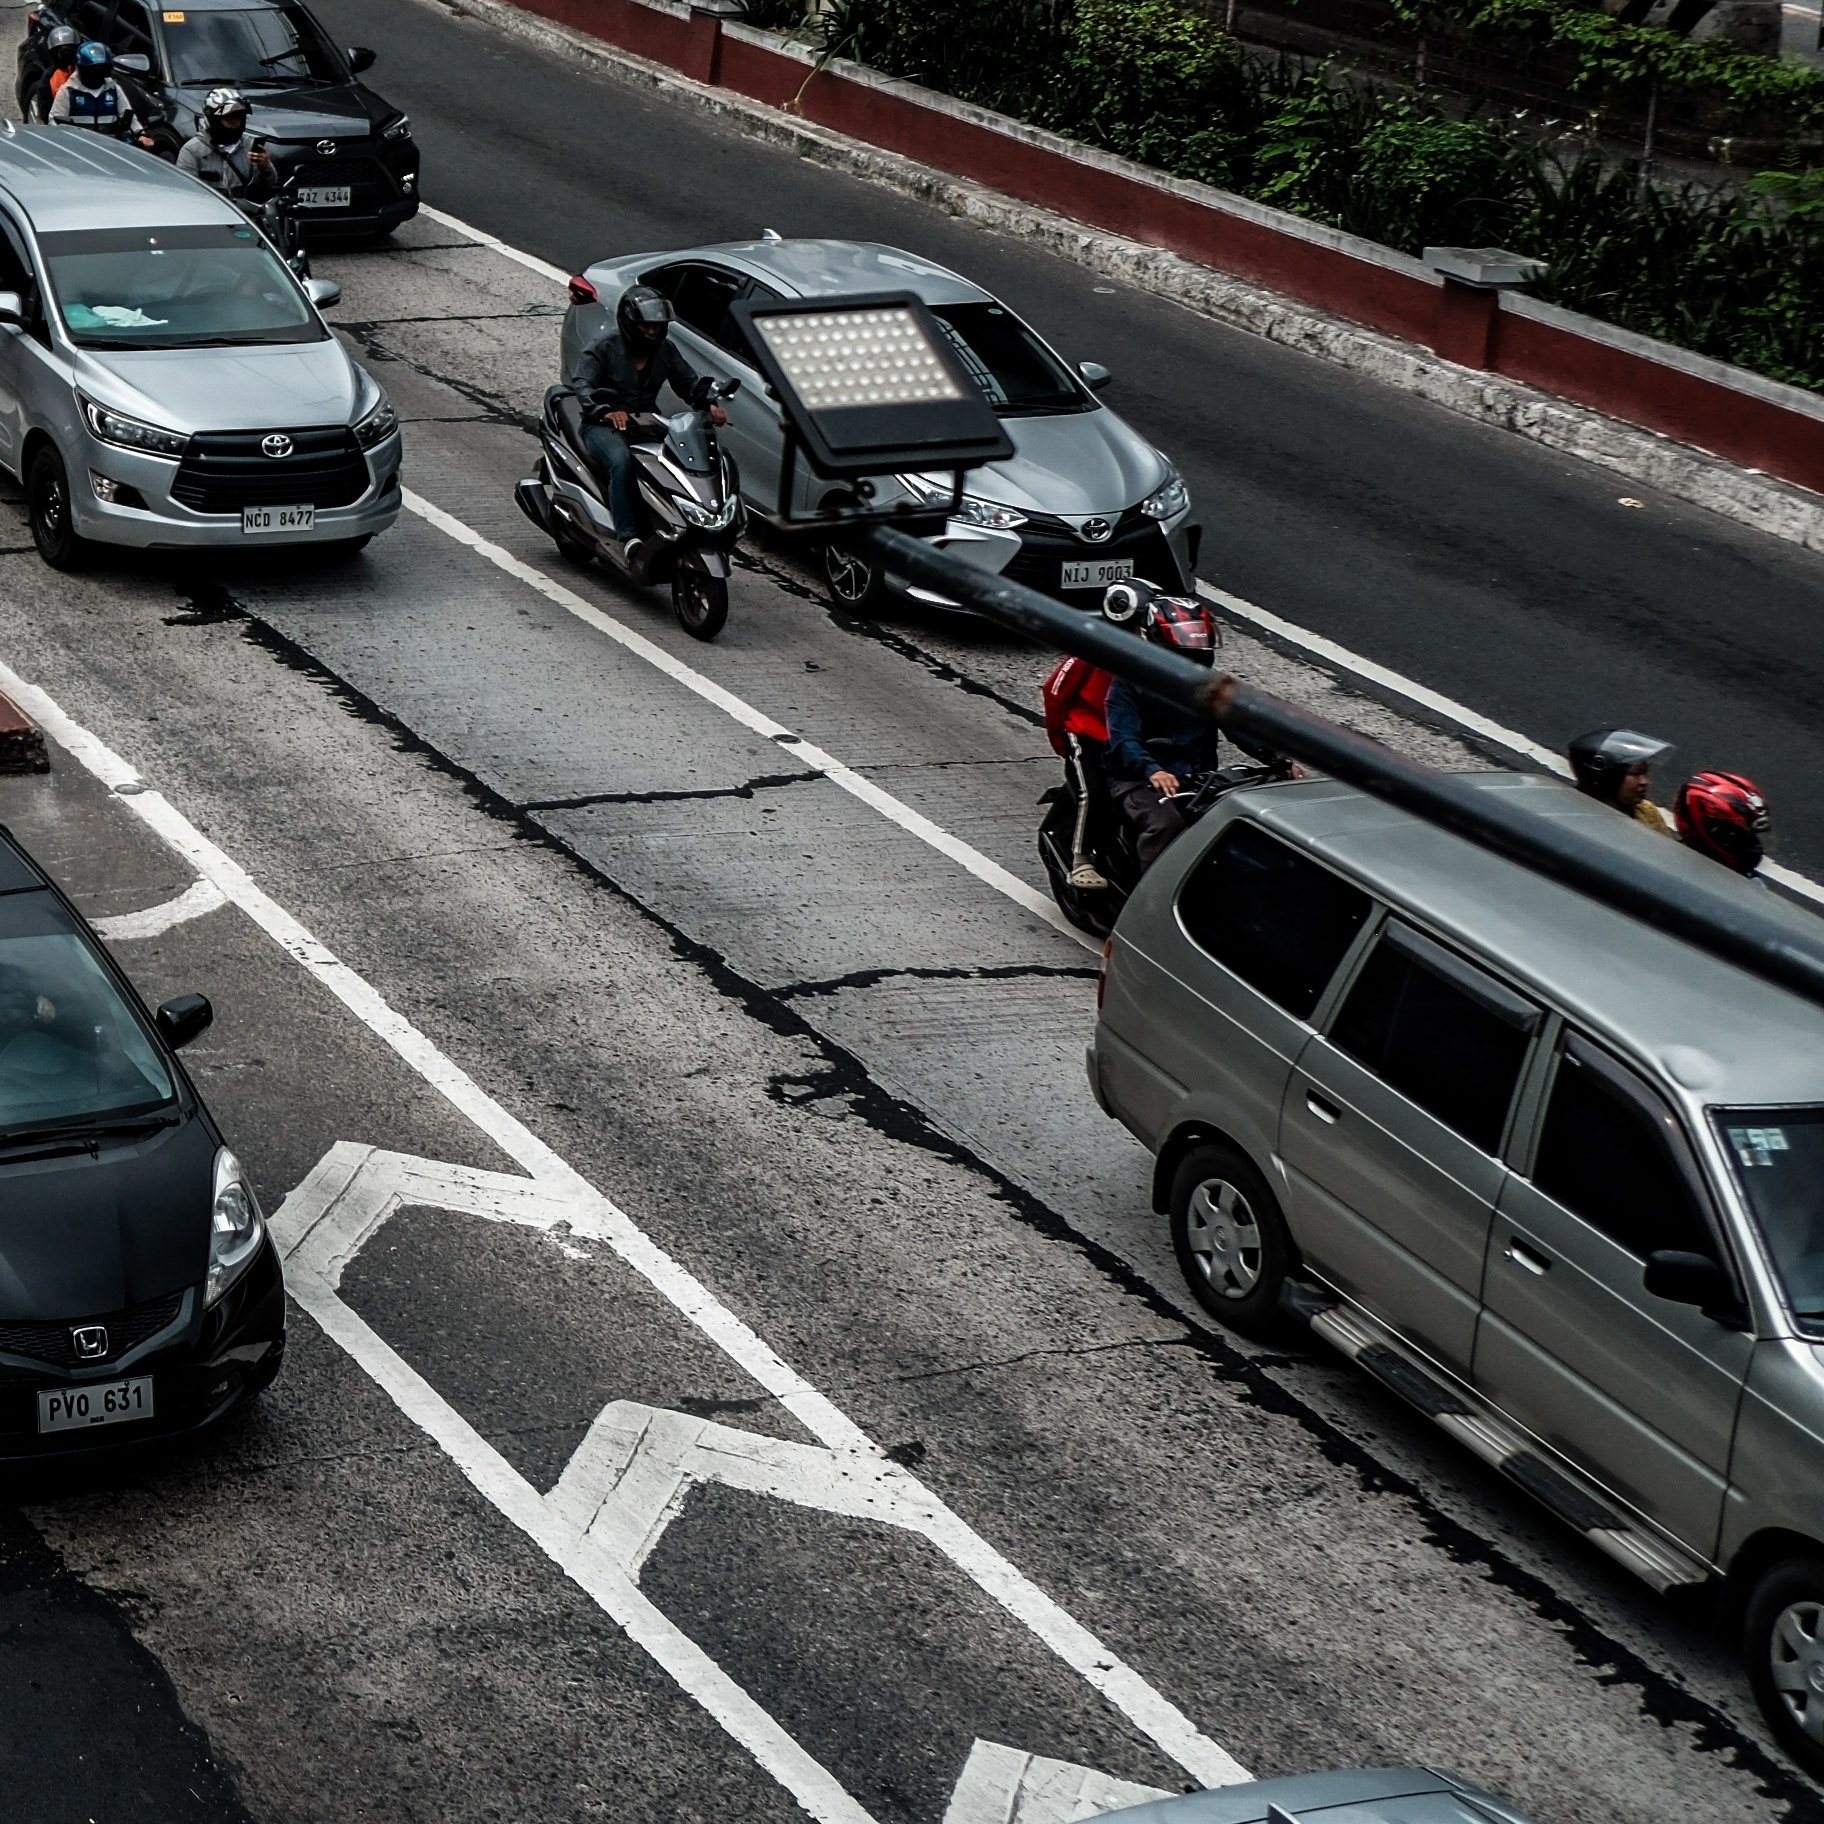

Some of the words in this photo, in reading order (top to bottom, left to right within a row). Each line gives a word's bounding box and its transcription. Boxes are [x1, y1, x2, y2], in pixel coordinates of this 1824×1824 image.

[324, 191, 349, 203] 4344
[246, 512, 270, 528] NCD
[280, 510, 312, 526] 8477
[1064, 566, 1089, 584] NIJ
[49, 1393, 89, 1422] PVO
[104, 1385, 142, 1413] 631
